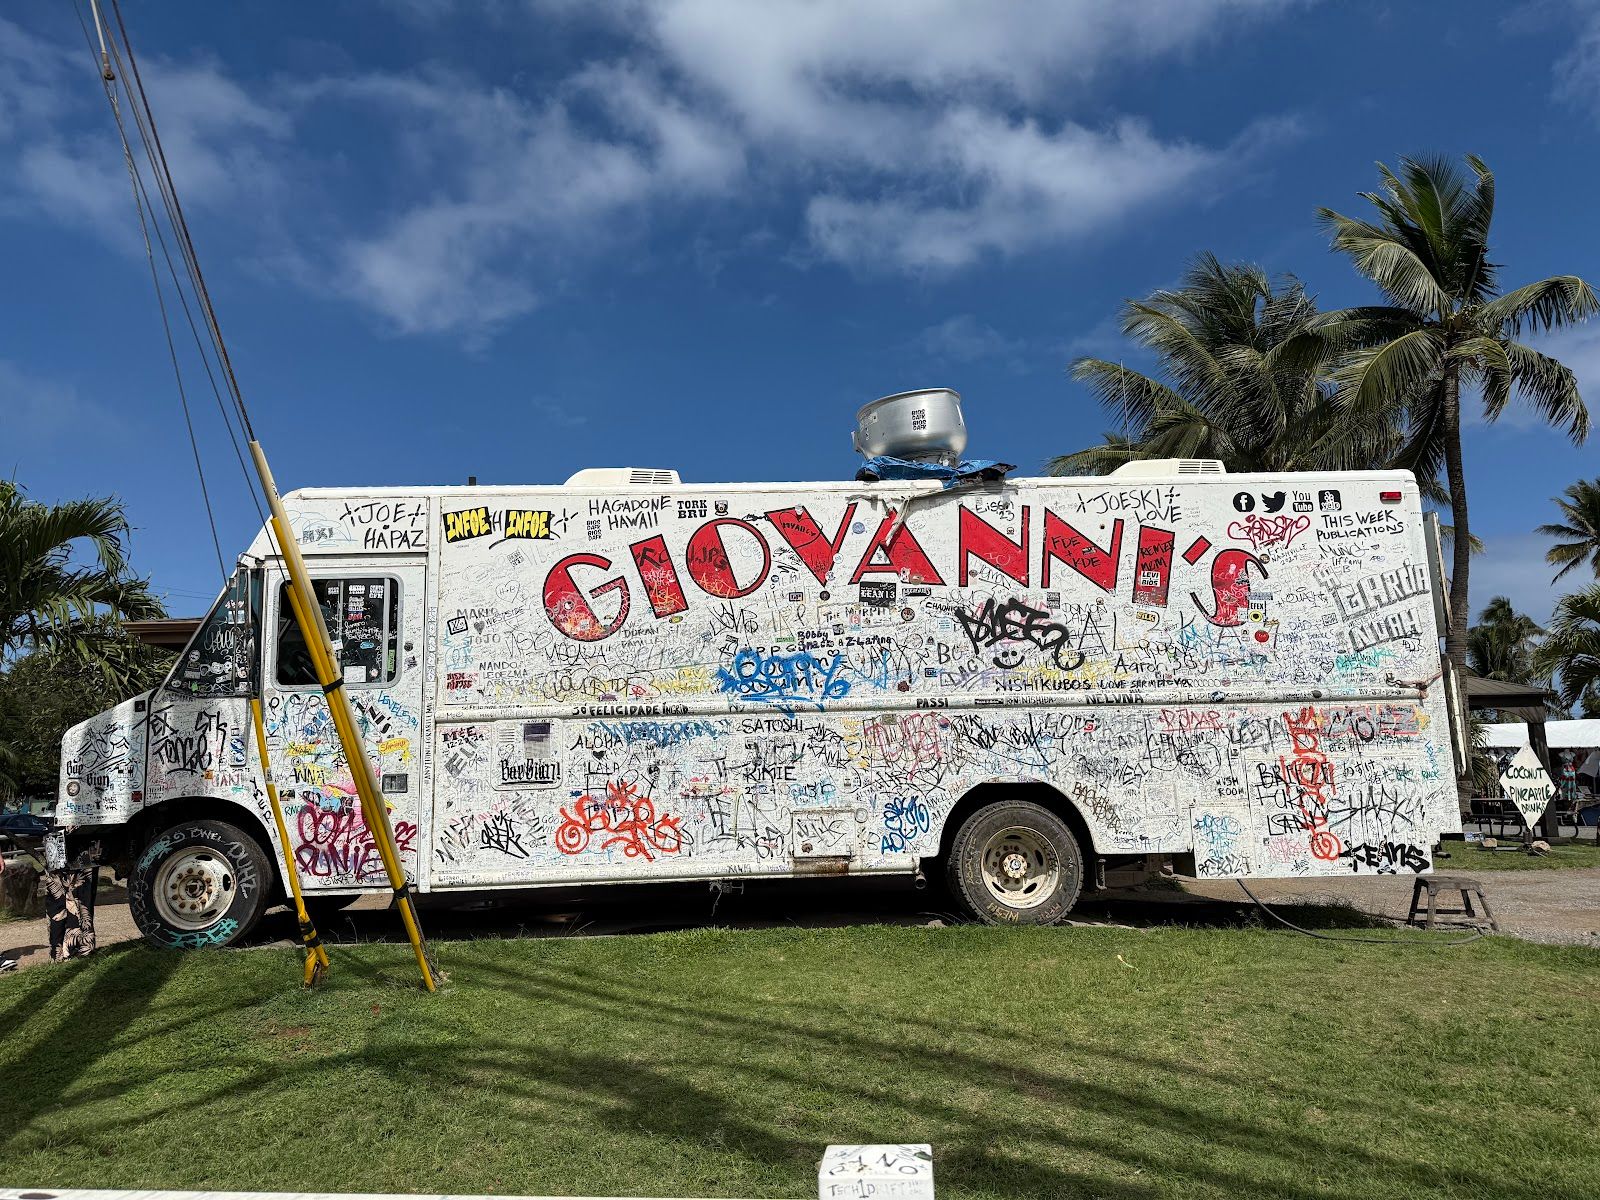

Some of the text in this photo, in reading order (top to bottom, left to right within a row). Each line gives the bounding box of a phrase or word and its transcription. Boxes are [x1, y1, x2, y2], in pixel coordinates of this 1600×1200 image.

[1292, 490, 1311, 501] You
[588, 496, 673, 516] HAGADONE
[677, 500, 708, 510] TORK
[1294, 502, 1313, 512] Tube
[1320, 501, 1341, 511] yelp
[678, 509, 708, 519] BRU
[1134, 505, 1182, 524] LOVE
[1321, 510, 1398, 528] THIS WEEK
[607, 511, 659, 531] HAWAII
[1316, 522, 1404, 542] PUBLICATIONS
[1073, 556, 1101, 569] KDE
[542, 501, 1269, 643] GIOVANNI'S
[1142, 571, 1159, 579] LEVI
[1250, 602, 1264, 610] EFEX
[479, 661, 518, 671] NANDO
[916, 698, 949, 708] PASSI
[590, 705, 660, 716] FELICIDADE
[742, 718, 803, 734] SATOSHI
[570, 734, 624, 750] ALOHA
[1505, 764, 1544, 780] COCONUT
[1218, 787, 1244, 797] ROOM
[1509, 784, 1552, 803] PINEAPPLE
[1520, 801, 1547, 815] DRINKS
